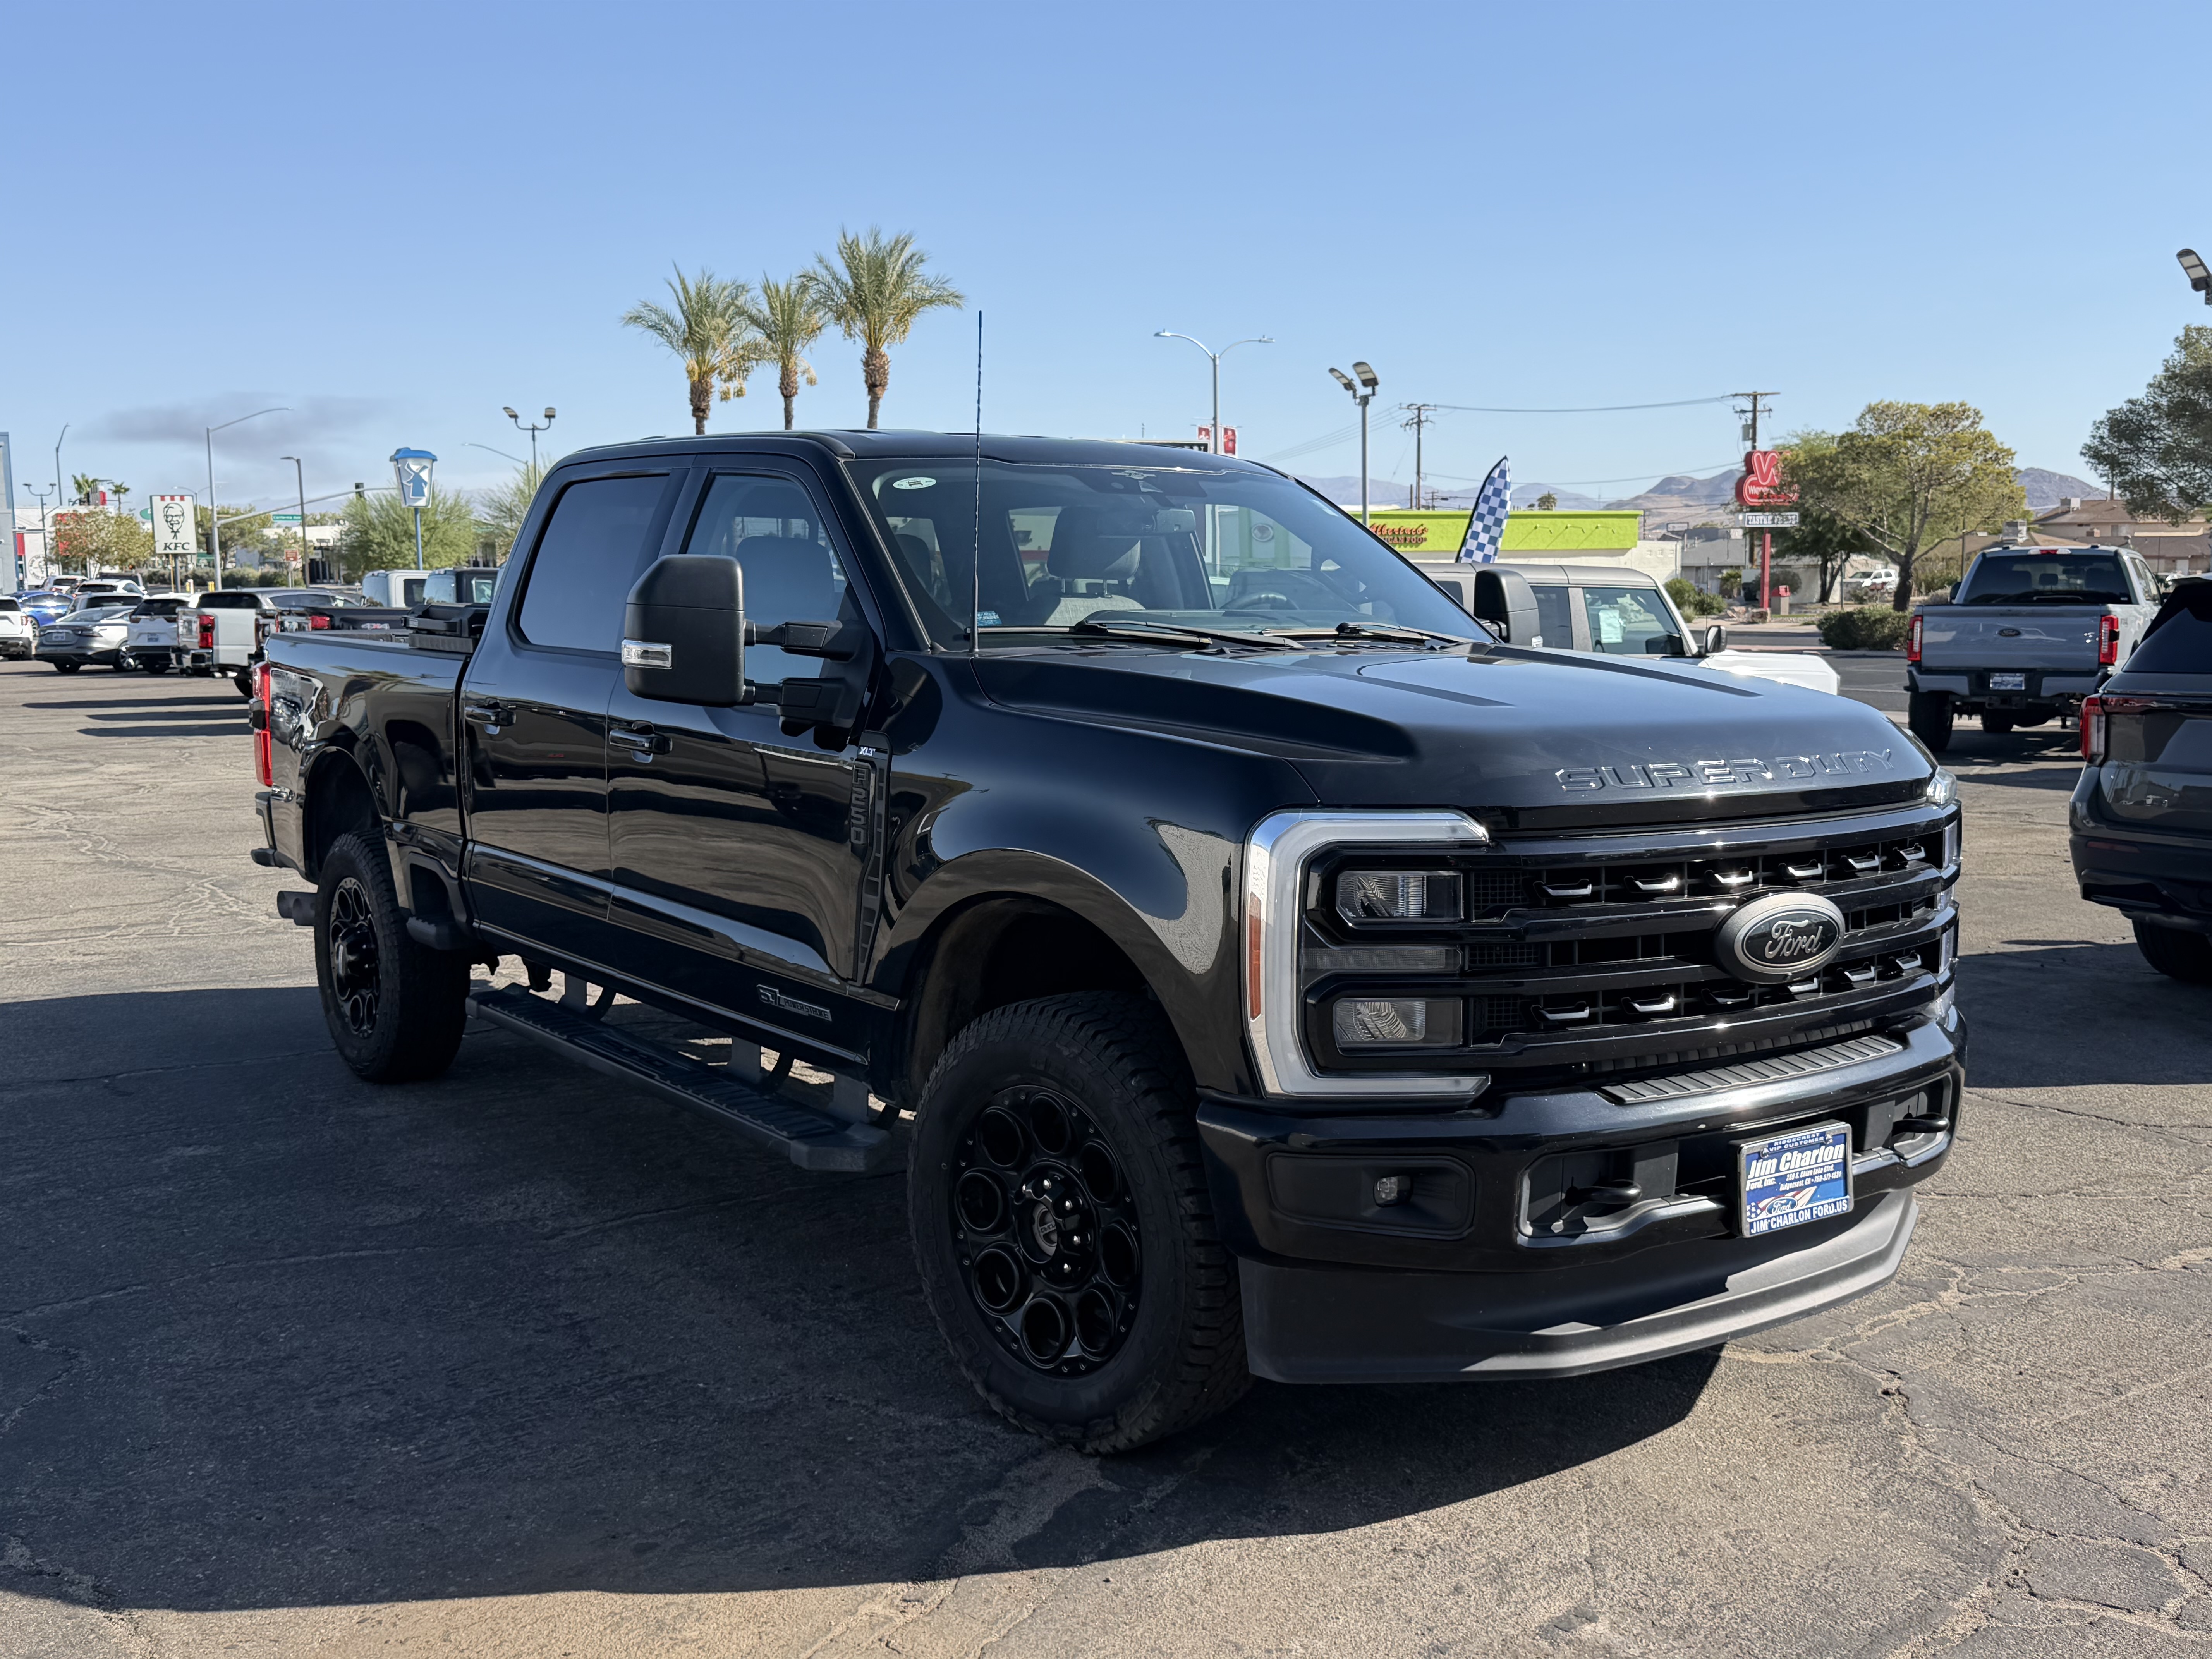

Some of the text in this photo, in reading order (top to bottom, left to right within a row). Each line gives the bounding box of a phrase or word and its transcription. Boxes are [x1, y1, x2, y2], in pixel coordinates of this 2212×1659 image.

[163, 542, 190, 551] KFC
[859, 746, 876, 756] XLT
[1555, 748, 1894, 791] SUPER DUTY
[1764, 919, 1823, 959] Ford
[1774, 1132, 1820, 1146] RIDGECREST
[1784, 1136, 1824, 1149] CUSTOMER
[1747, 1143, 1845, 1179] Jim Charlon
[1771, 1199, 1792, 1214] Ford
[1751, 1199, 1848, 1234] JIM CHARLON FORD.US
